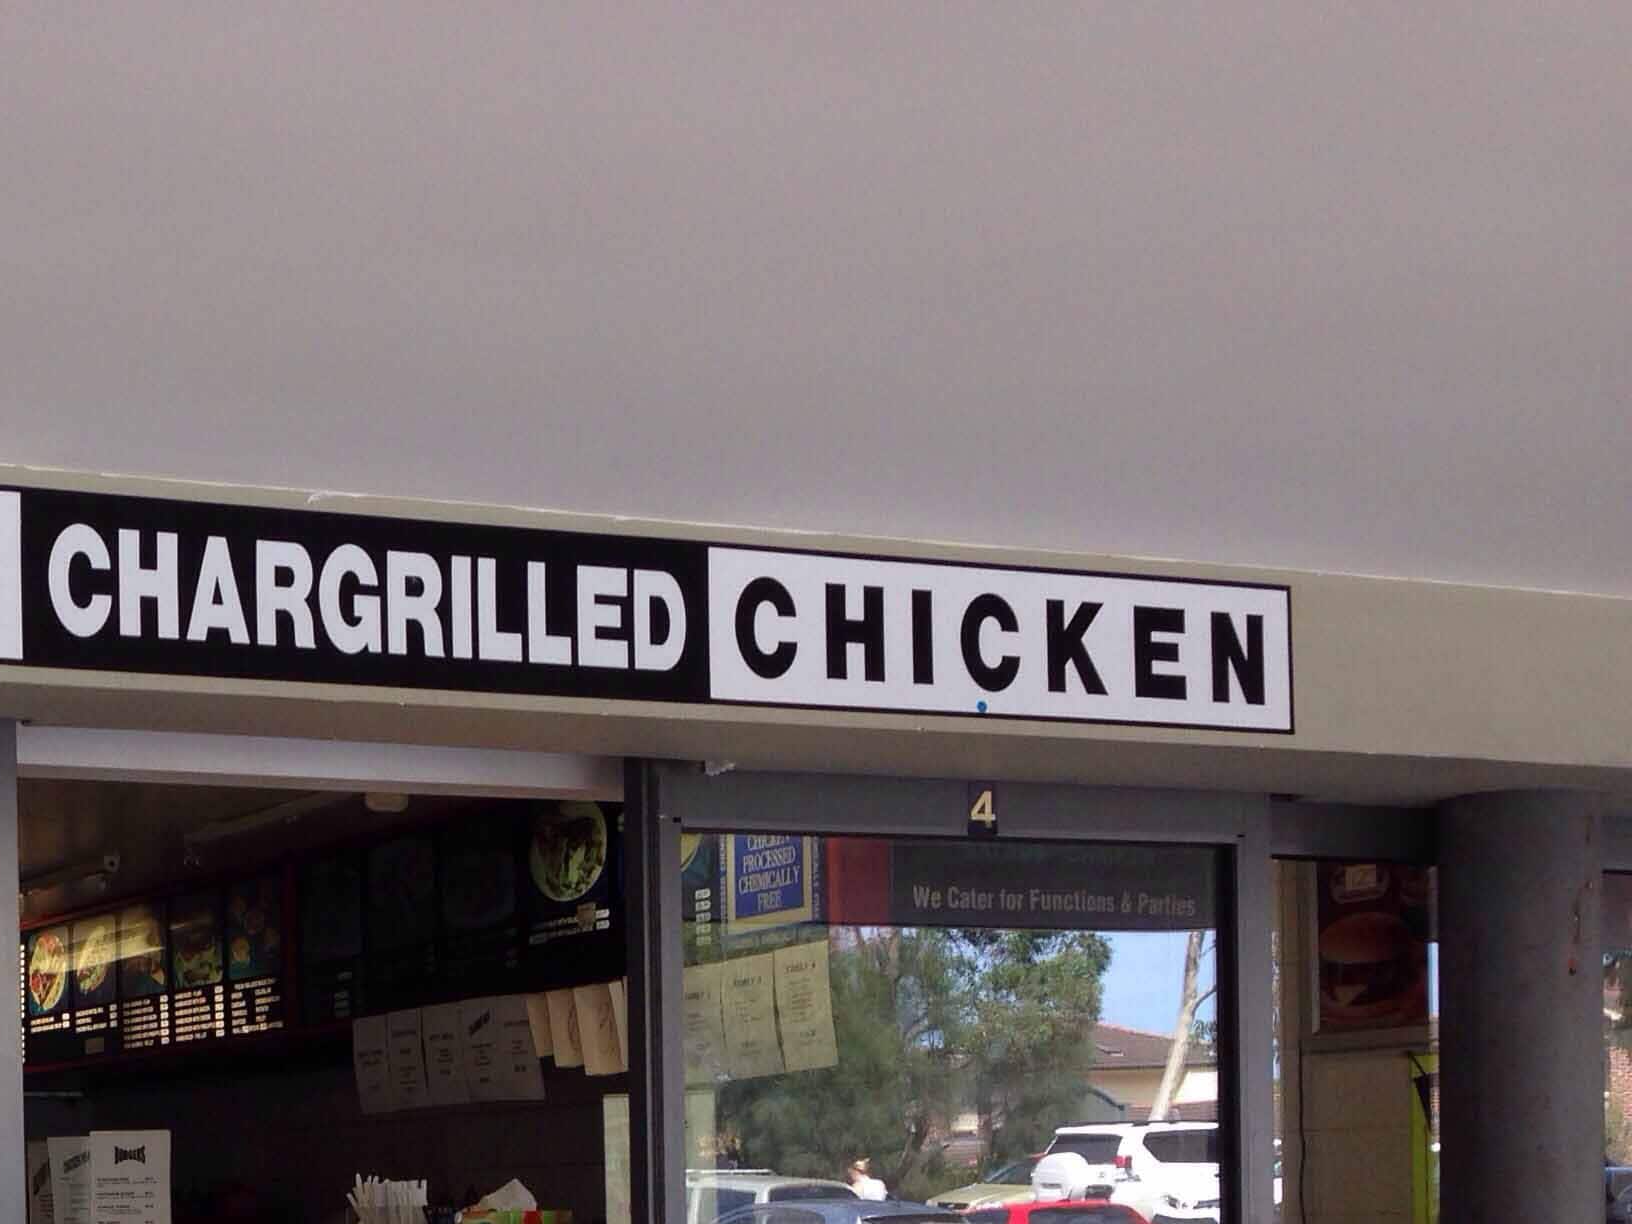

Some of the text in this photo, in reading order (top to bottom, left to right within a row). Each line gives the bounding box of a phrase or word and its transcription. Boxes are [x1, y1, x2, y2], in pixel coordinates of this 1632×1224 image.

[48, 523, 687, 673] CHARGRILLED
[734, 576, 1265, 706] CHICKEN
[970, 790, 996, 828] 4
[913, 885, 1196, 917] We Cater for Functions & Parties
